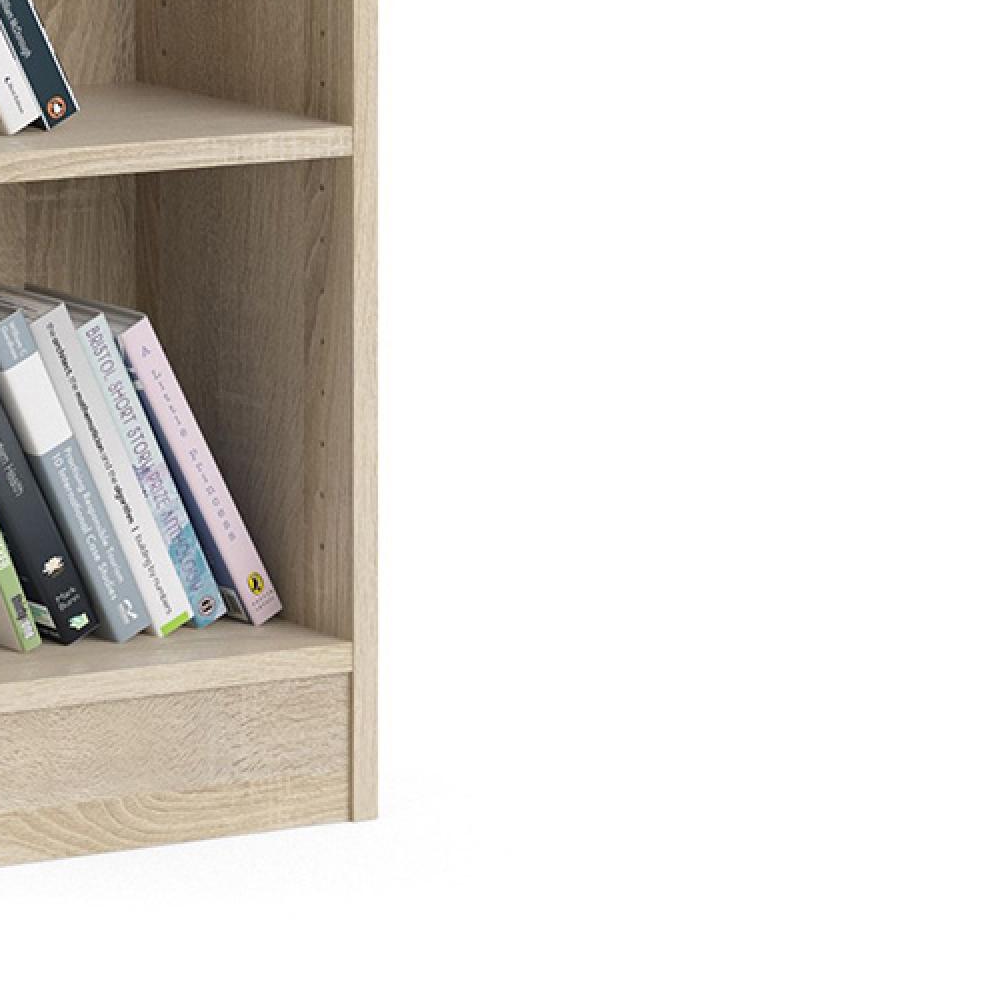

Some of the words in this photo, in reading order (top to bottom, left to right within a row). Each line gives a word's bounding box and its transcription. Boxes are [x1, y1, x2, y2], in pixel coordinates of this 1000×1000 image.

[141, 345, 151, 357] A
[76, 392, 104, 453] mathematician
[85, 325, 116, 379] BRISTOL
[107, 380, 137, 425] SHORT
[127, 425, 155, 471] STORY
[145, 471, 173, 510] PRIZE
[86, 534, 101, 562] Case
[98, 561, 117, 600] Studies
